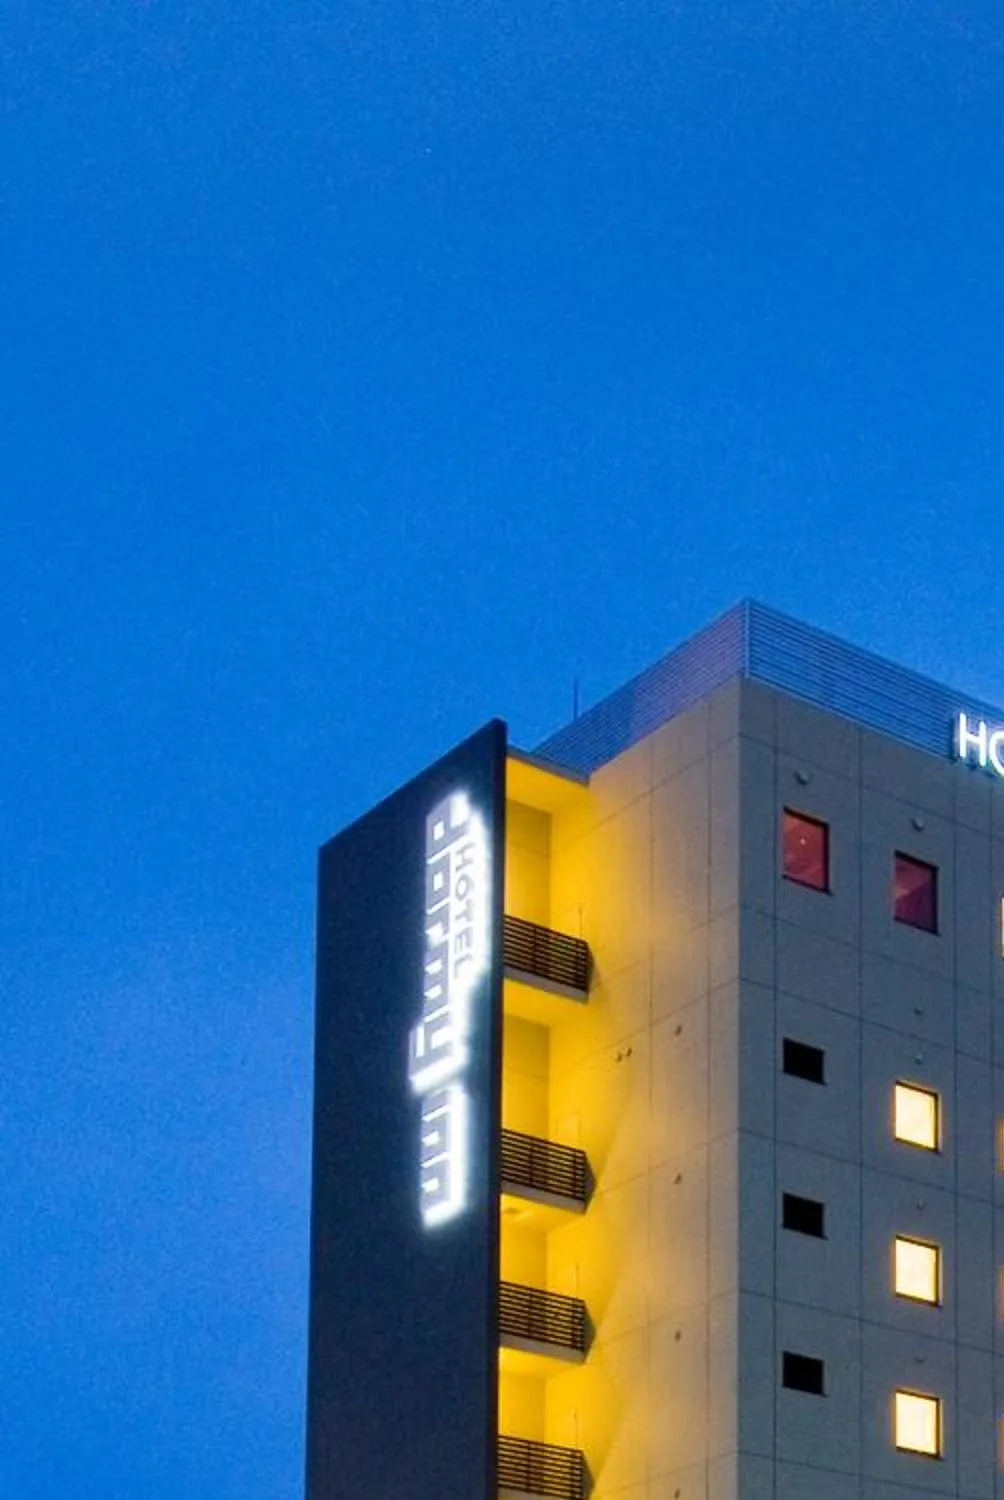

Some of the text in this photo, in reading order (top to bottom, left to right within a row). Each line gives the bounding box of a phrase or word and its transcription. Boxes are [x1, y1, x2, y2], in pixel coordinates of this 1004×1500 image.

[408, 796, 469, 1216] dormy inn
[453, 841, 478, 980] HOTEL
